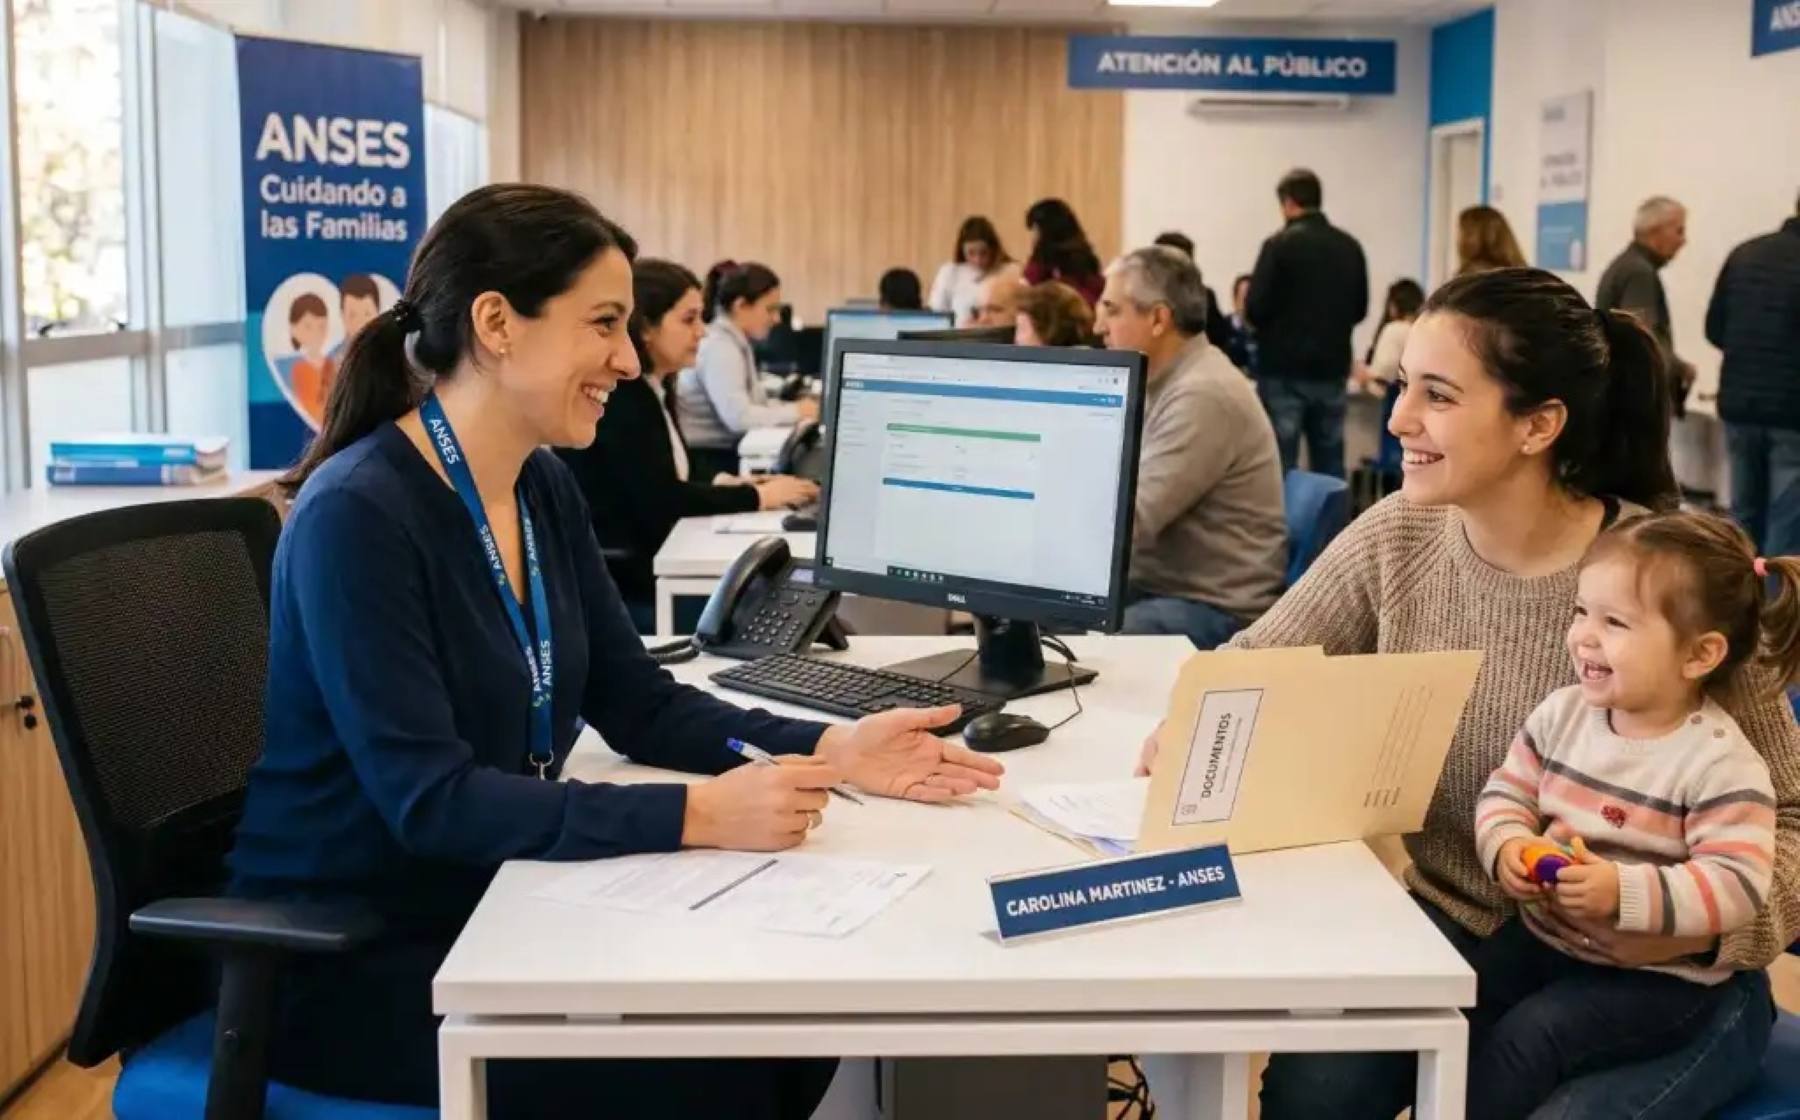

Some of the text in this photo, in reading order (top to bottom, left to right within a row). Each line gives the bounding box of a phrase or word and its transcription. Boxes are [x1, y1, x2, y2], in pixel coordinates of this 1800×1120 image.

[1098, 49, 1367, 78] ATENCIÓN AL PÚBLICO
[256, 112, 411, 168] ANSES
[260, 173, 407, 208] Cuidando a
[261, 209, 407, 242] las Familias
[430, 419, 459, 464] ANSES
[479, 524, 503, 570] ANSES
[541, 640, 552, 686] ANSES
[1201, 712, 1232, 798] DOCUMENTOS
[1006, 889, 1088, 917] CAROLINA
[1089, 875, 1167, 903] MARTINEZ
[1178, 865, 1226, 888] ANSES
